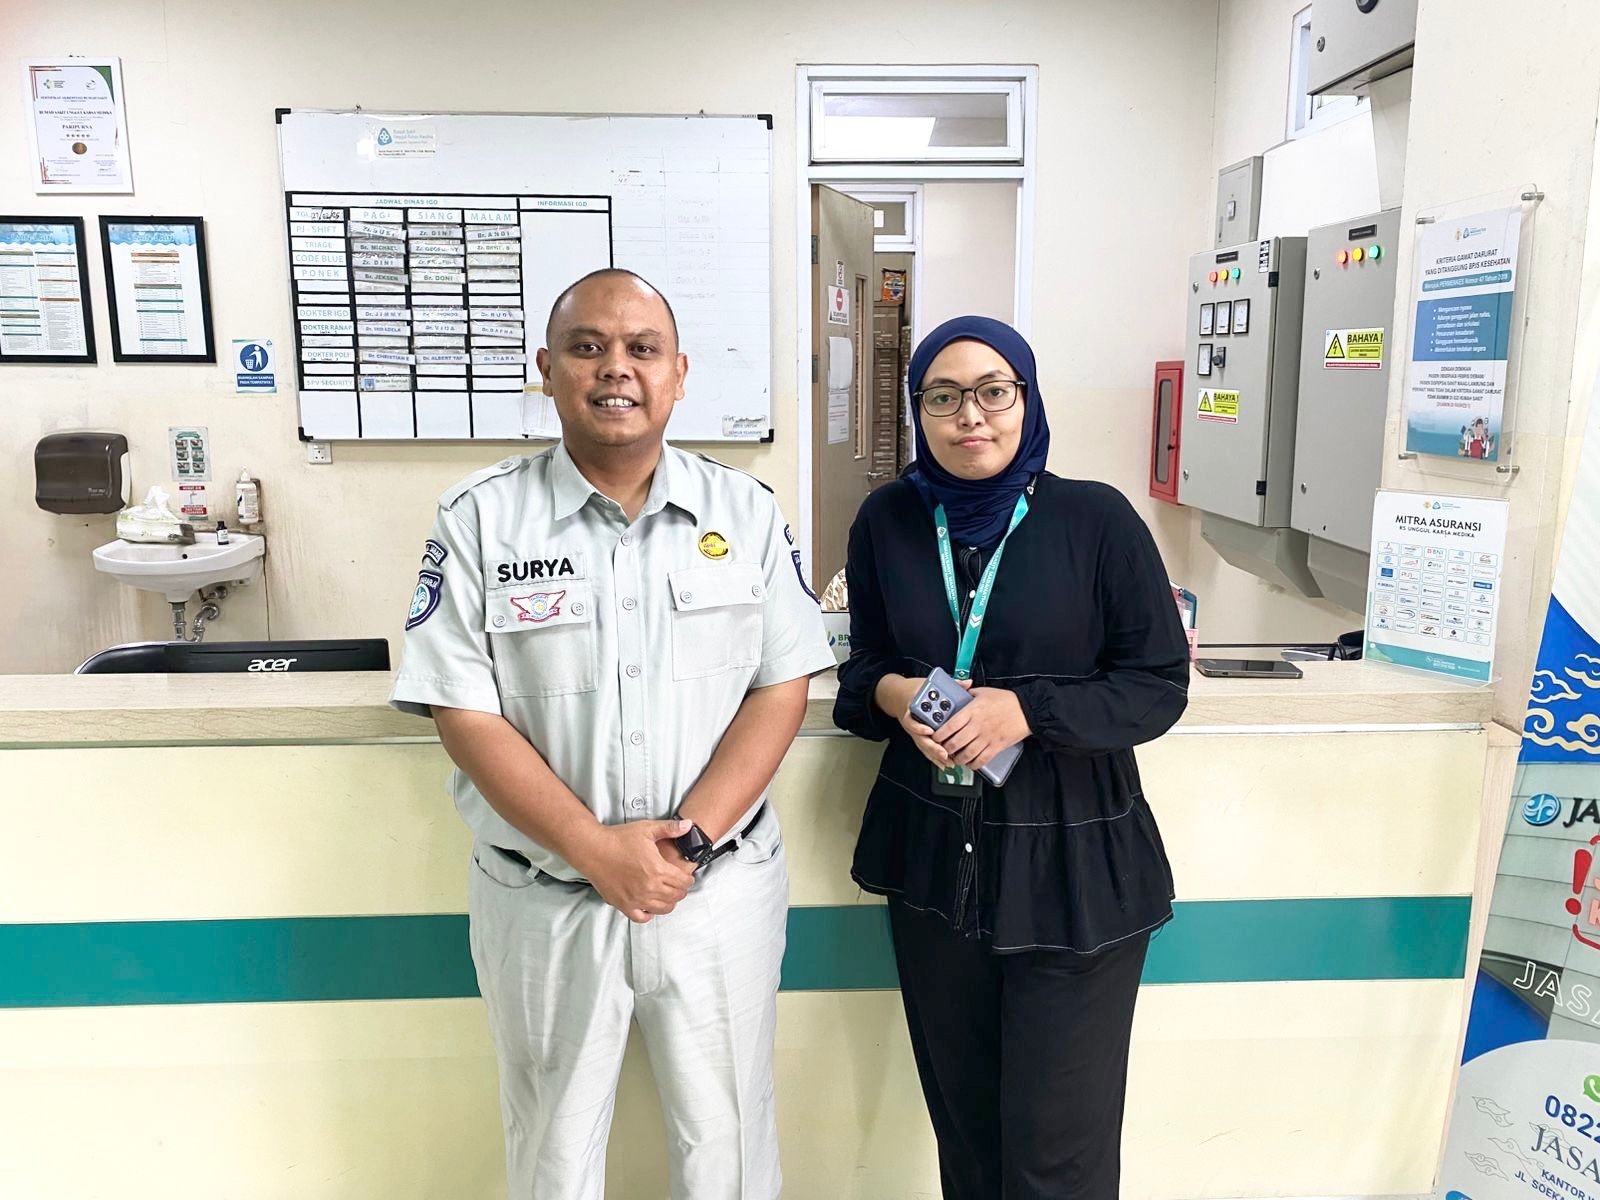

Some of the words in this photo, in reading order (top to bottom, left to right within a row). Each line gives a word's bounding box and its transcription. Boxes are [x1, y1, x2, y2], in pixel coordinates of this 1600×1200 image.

[363, 212, 391, 220] PAGI
[418, 212, 453, 220] SIANG
[471, 213, 512, 221] MALAM
[296, 255, 319, 263] CODE
[322, 255, 344, 263] BLUE
[1436, 256, 1456, 265] KRITERIA
[1457, 253, 1474, 262] GAWAT
[1474, 249, 1498, 259] DARURAT
[1438, 264, 1468, 275] DITANGGUNG
[1481, 257, 1511, 268] KESEHATAN
[1348, 333, 1379, 343] BAHAYA
[1214, 393, 1236, 401] BAHAYA
[1396, 515, 1427, 526] MITRA
[1429, 518, 1482, 532] ASURANSI
[1408, 526, 1431, 534] UNGGUL
[497, 557, 575, 583] SURYA
[248, 657, 297, 672] acer
[1515, 1170, 1527, 1183] JL
[1541, 1169, 1585, 1200] KANTOR
